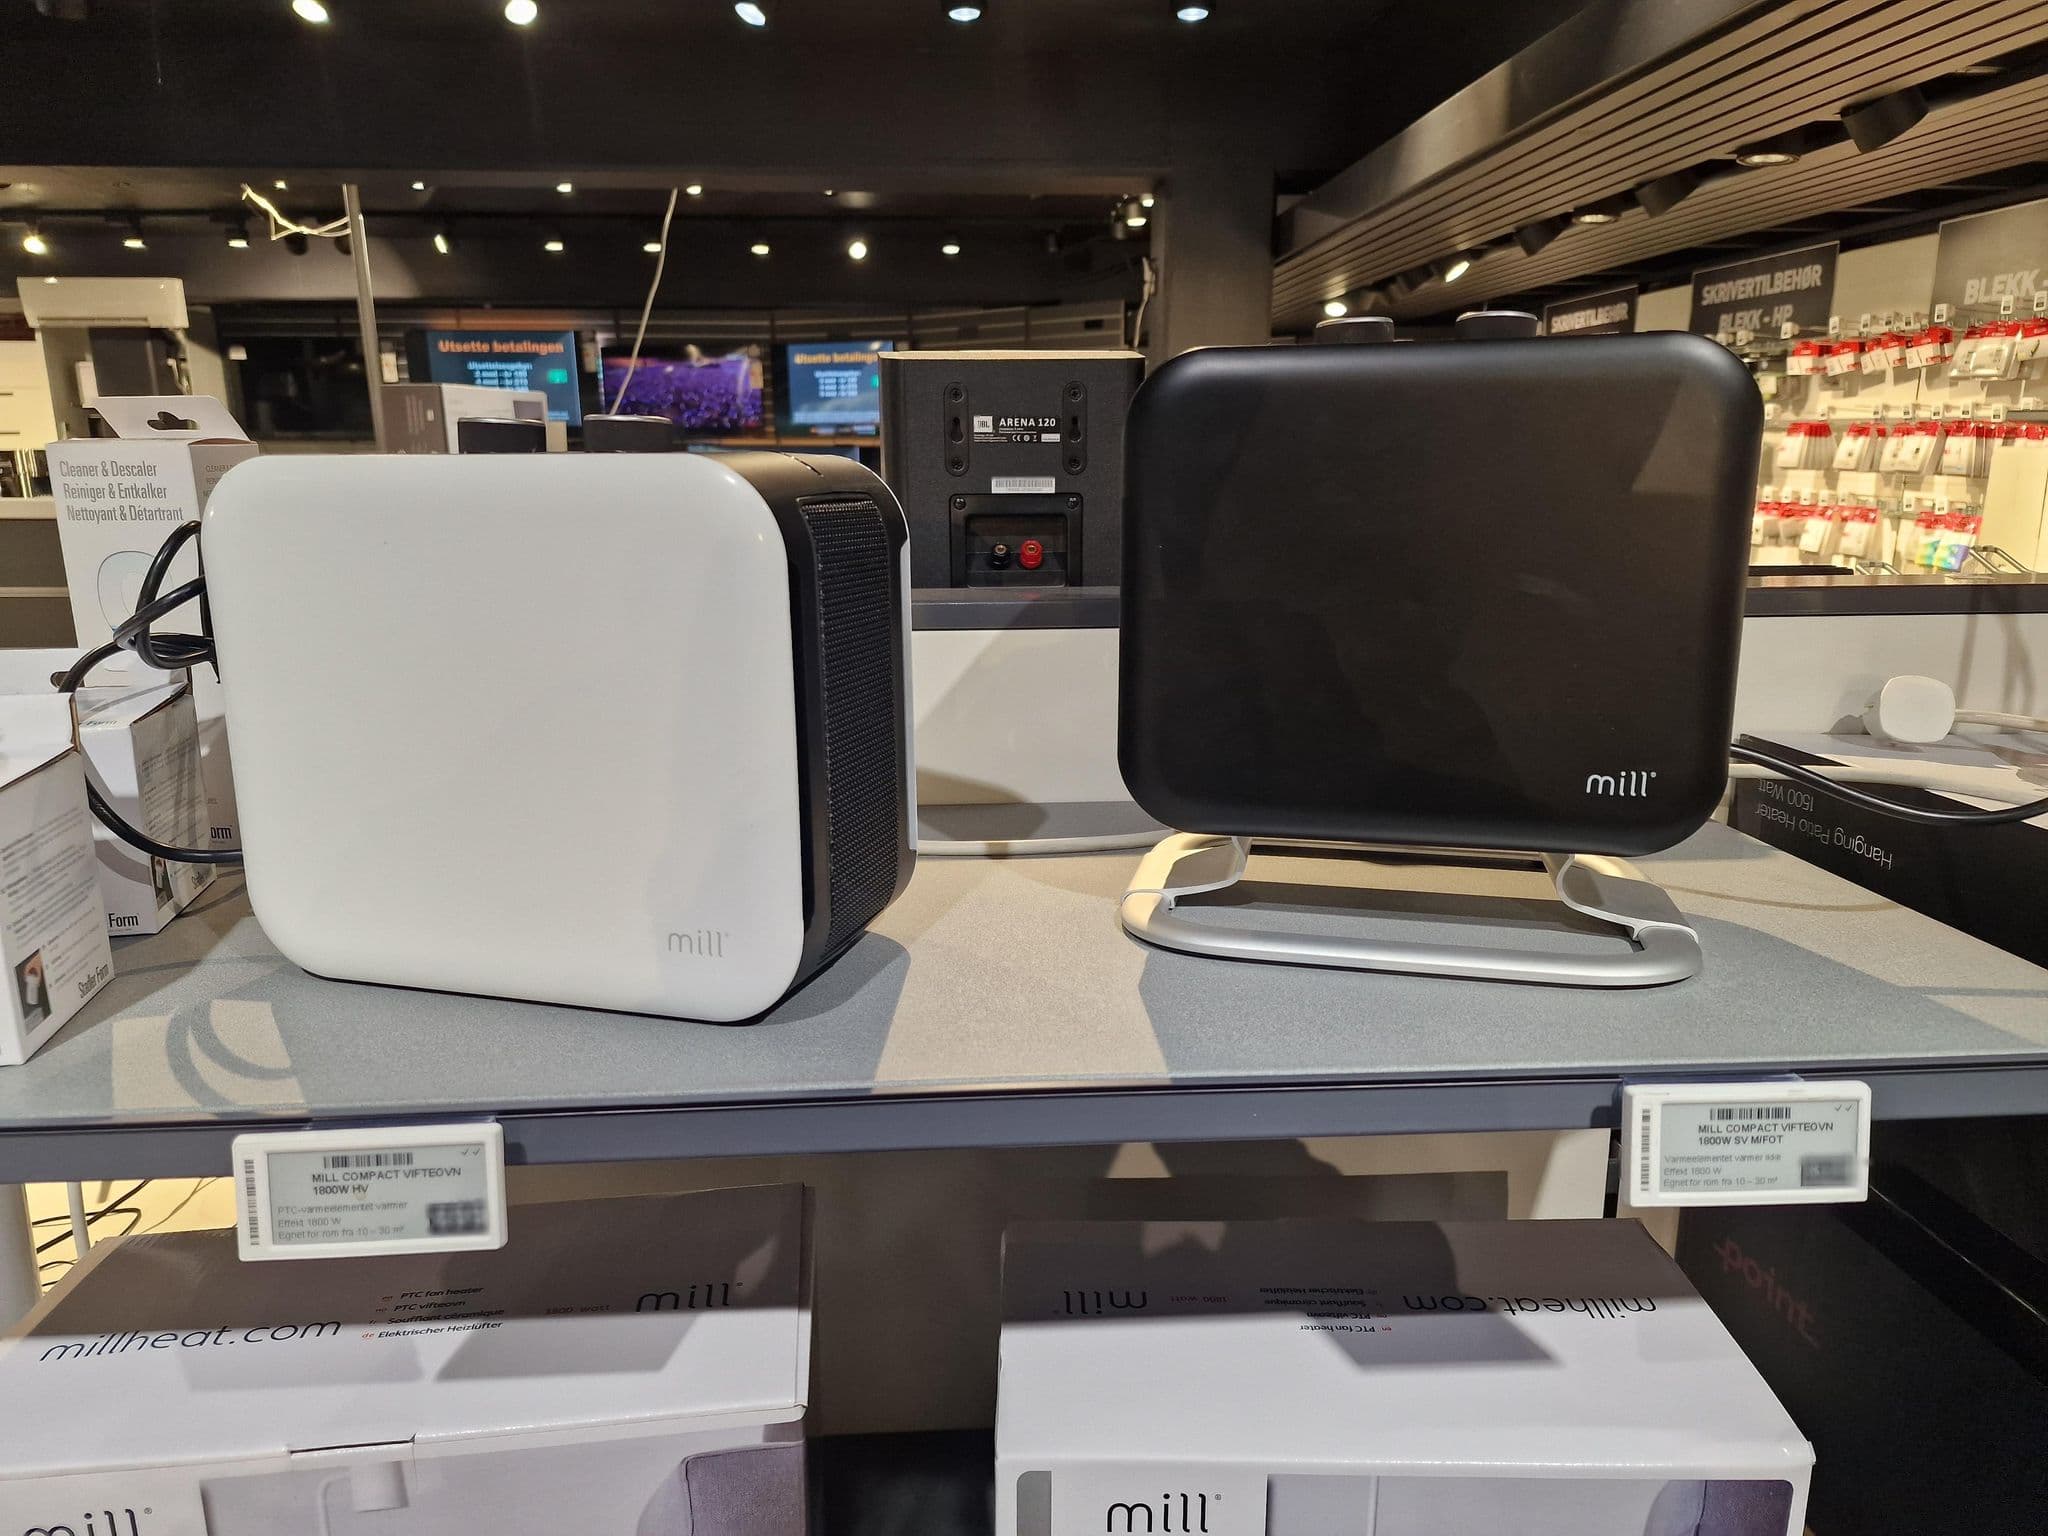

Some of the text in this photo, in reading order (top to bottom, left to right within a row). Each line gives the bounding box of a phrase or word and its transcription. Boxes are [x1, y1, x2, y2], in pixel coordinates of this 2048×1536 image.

[1701, 264, 1822, 306] SKRIVERTILBEHØR
[1964, 268, 2040, 305] BLEKK
[1718, 308, 1763, 334] BLEKK
[1771, 303, 1793, 328] HP
[438, 340, 564, 355] Utsette betalingen
[999, 417, 1056, 427] ARENA 120
[59, 460, 157, 477] Cleaner & Descaler
[63, 483, 168, 502] Reiniger & Entkalker
[66, 504, 184, 524] Nettoyant & Détartrant
[1787, 788, 1814, 812] 1500
[1754, 803, 1796, 831] Heater
[1834, 826, 1893, 871] Hanging
[109, 913, 139, 928] Form
[1698, 1121, 1834, 1134] MILL COMPACT VIFTEOVN
[1699, 1134, 1784, 1145] 1800W SV M/FOT
[312, 1167, 462, 1183] MILL COMPACT VIFTEOVN
[1664, 1167, 1688, 1176] Effekt
[1712, 1167, 1722, 1175] W
[313, 1184, 370, 1195] 1800W HV
[1664, 1178, 1688, 1188] Egnet
[1690, 1178, 1700, 1187] for
[1703, 1179, 1719, 1187] rom
[1721, 1178, 1733, 1186] fra
[1736, 1177, 1745, 1186] 10
[278, 1217, 342, 1228] Effekt 1800 W
[278, 1230, 305, 1240] Egnet
[307, 1229, 319, 1239] for
[322, 1230, 339, 1239] rom
[342, 1227, 354, 1237] fra
[358, 1227, 369, 1236] 10
[379, 1225, 391, 1235] 30
[400, 1291, 424, 1299] PTC
[424, 1290, 444, 1298] fan
[446, 1287, 485, 1296] heater
[393, 1303, 418, 1312] PTC
[419, 1300, 467, 1310] vifteovn
[1402, 1295, 1658, 1320] millheat.com
[377, 1326, 446, 1339] Elektrischer
[446, 1322, 504, 1333] Heizlüfter
[1299, 1325, 1334, 1333] heater
[1336, 1325, 1354, 1333] fan
[1355, 1325, 1376, 1333] PTC
[39, 1319, 344, 1362] millheat.com
